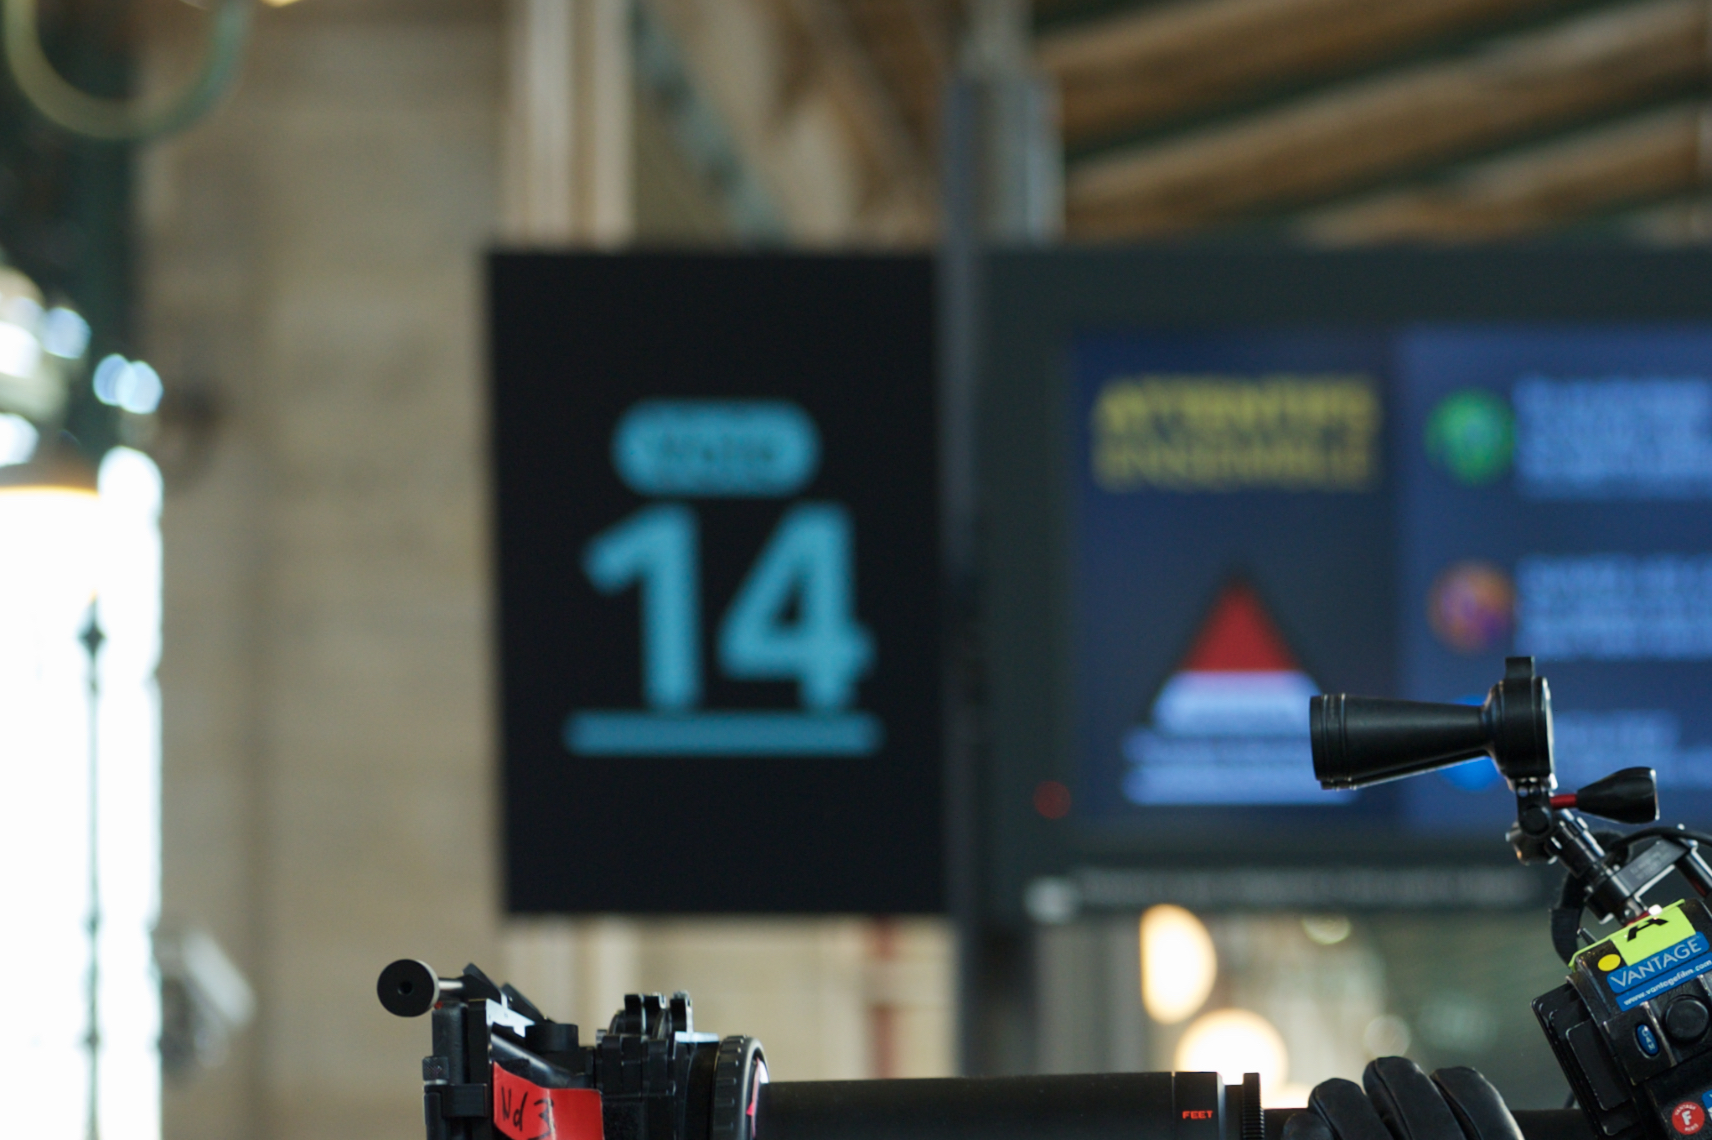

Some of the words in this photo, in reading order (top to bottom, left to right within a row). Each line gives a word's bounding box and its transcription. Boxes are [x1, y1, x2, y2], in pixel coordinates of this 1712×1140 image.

[582, 501, 878, 713] 14
[1610, 938, 1702, 987] VANTAGE
[1624, 959, 1712, 1006] www.vantagefilm.com
[1182, 1110, 1213, 1119] FEET
[1681, 1110, 1692, 1126] F
